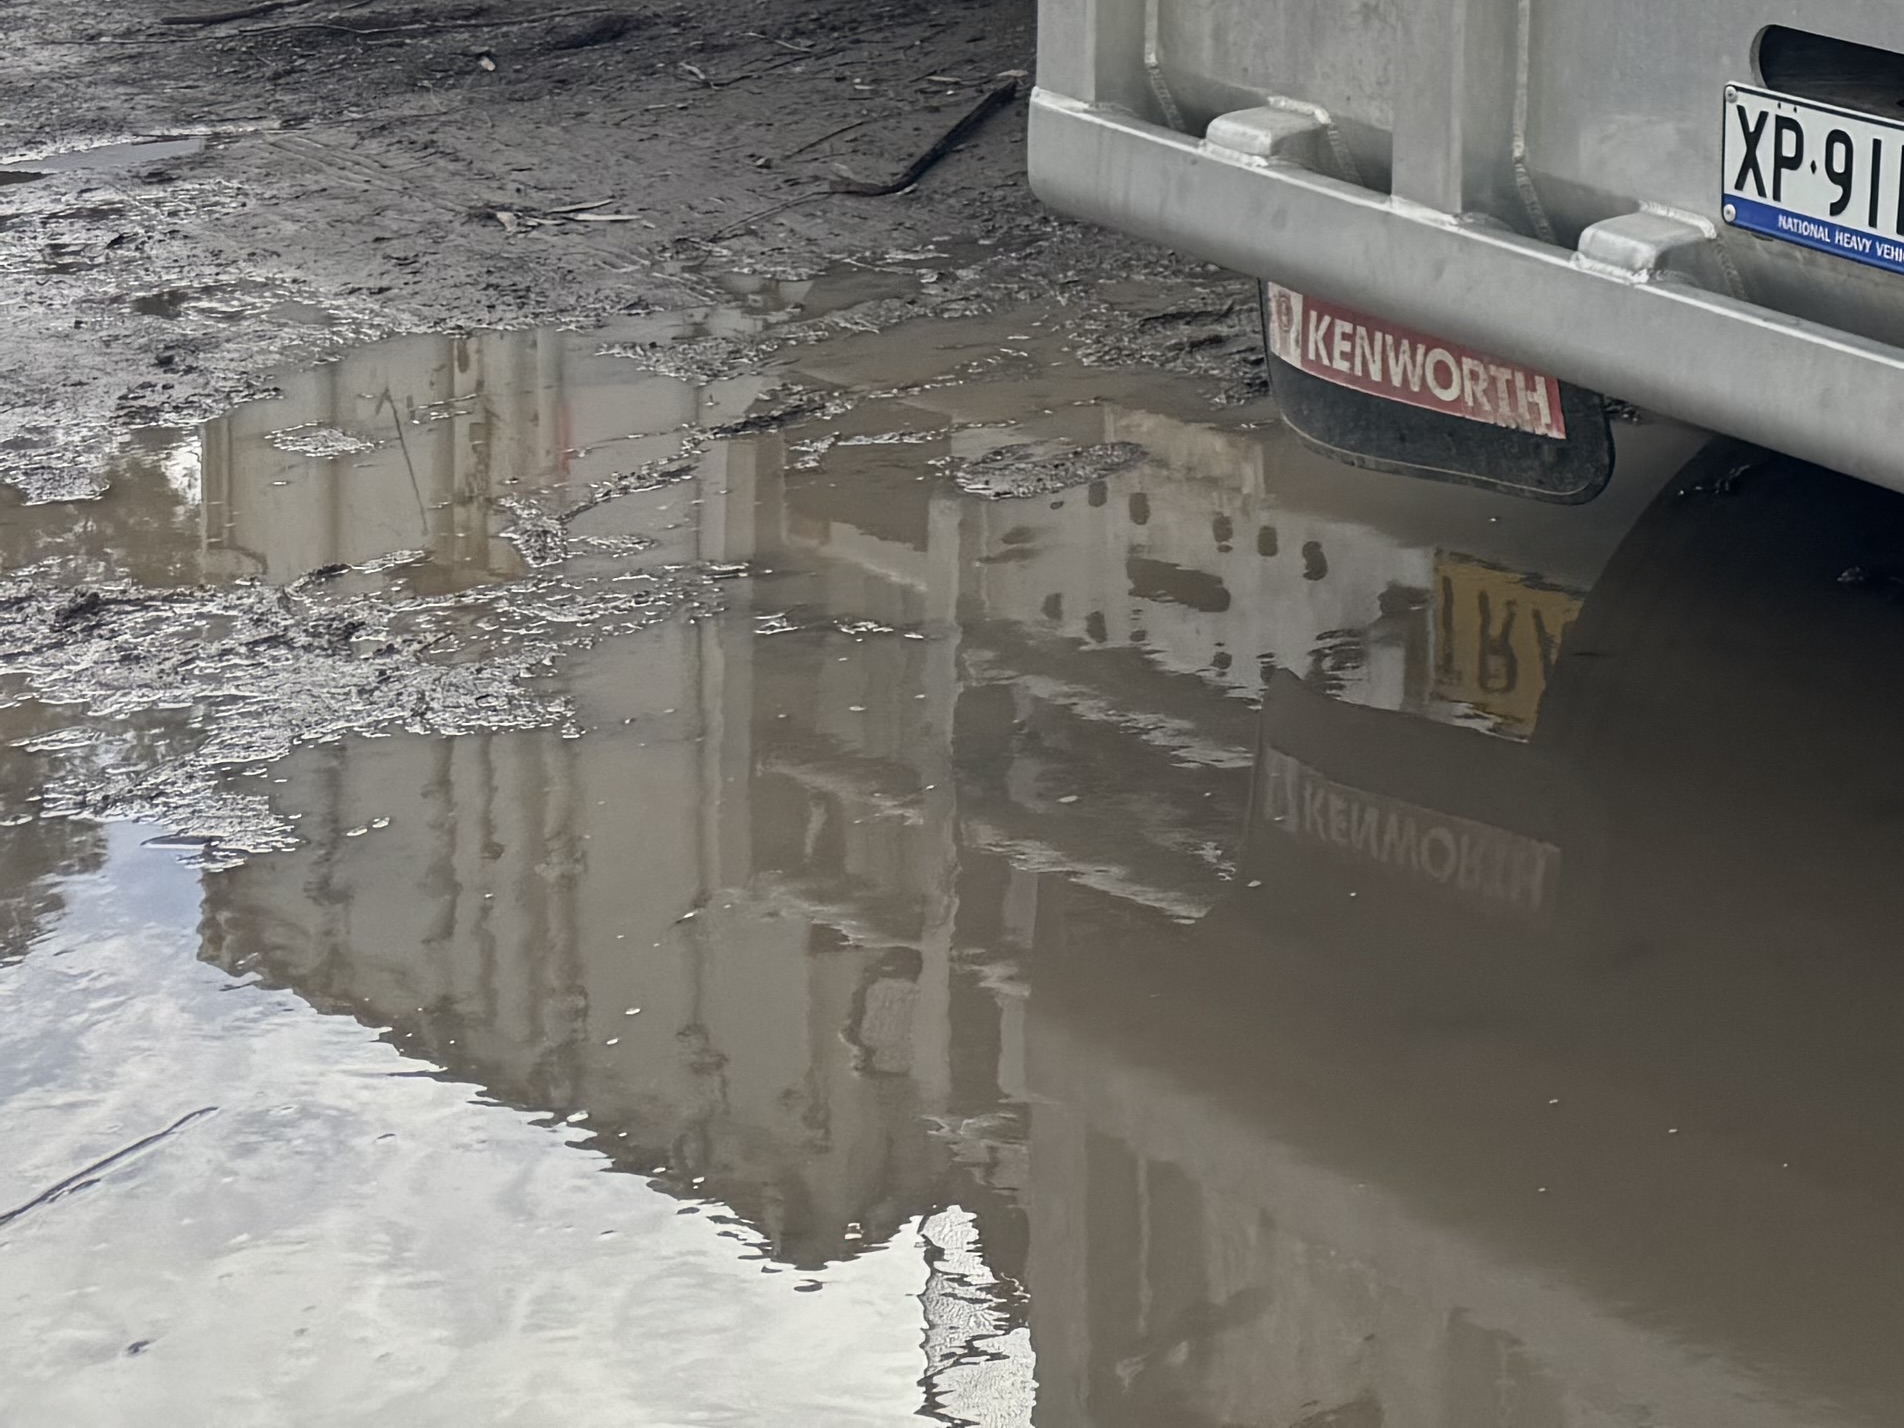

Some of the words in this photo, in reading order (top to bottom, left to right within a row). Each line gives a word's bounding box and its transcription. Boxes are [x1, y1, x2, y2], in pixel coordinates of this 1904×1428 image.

[1777, 214, 1831, 244] NATIONAL
[1834, 227, 1873, 254] HEAVY
[1307, 310, 1552, 427] KENWORTH
